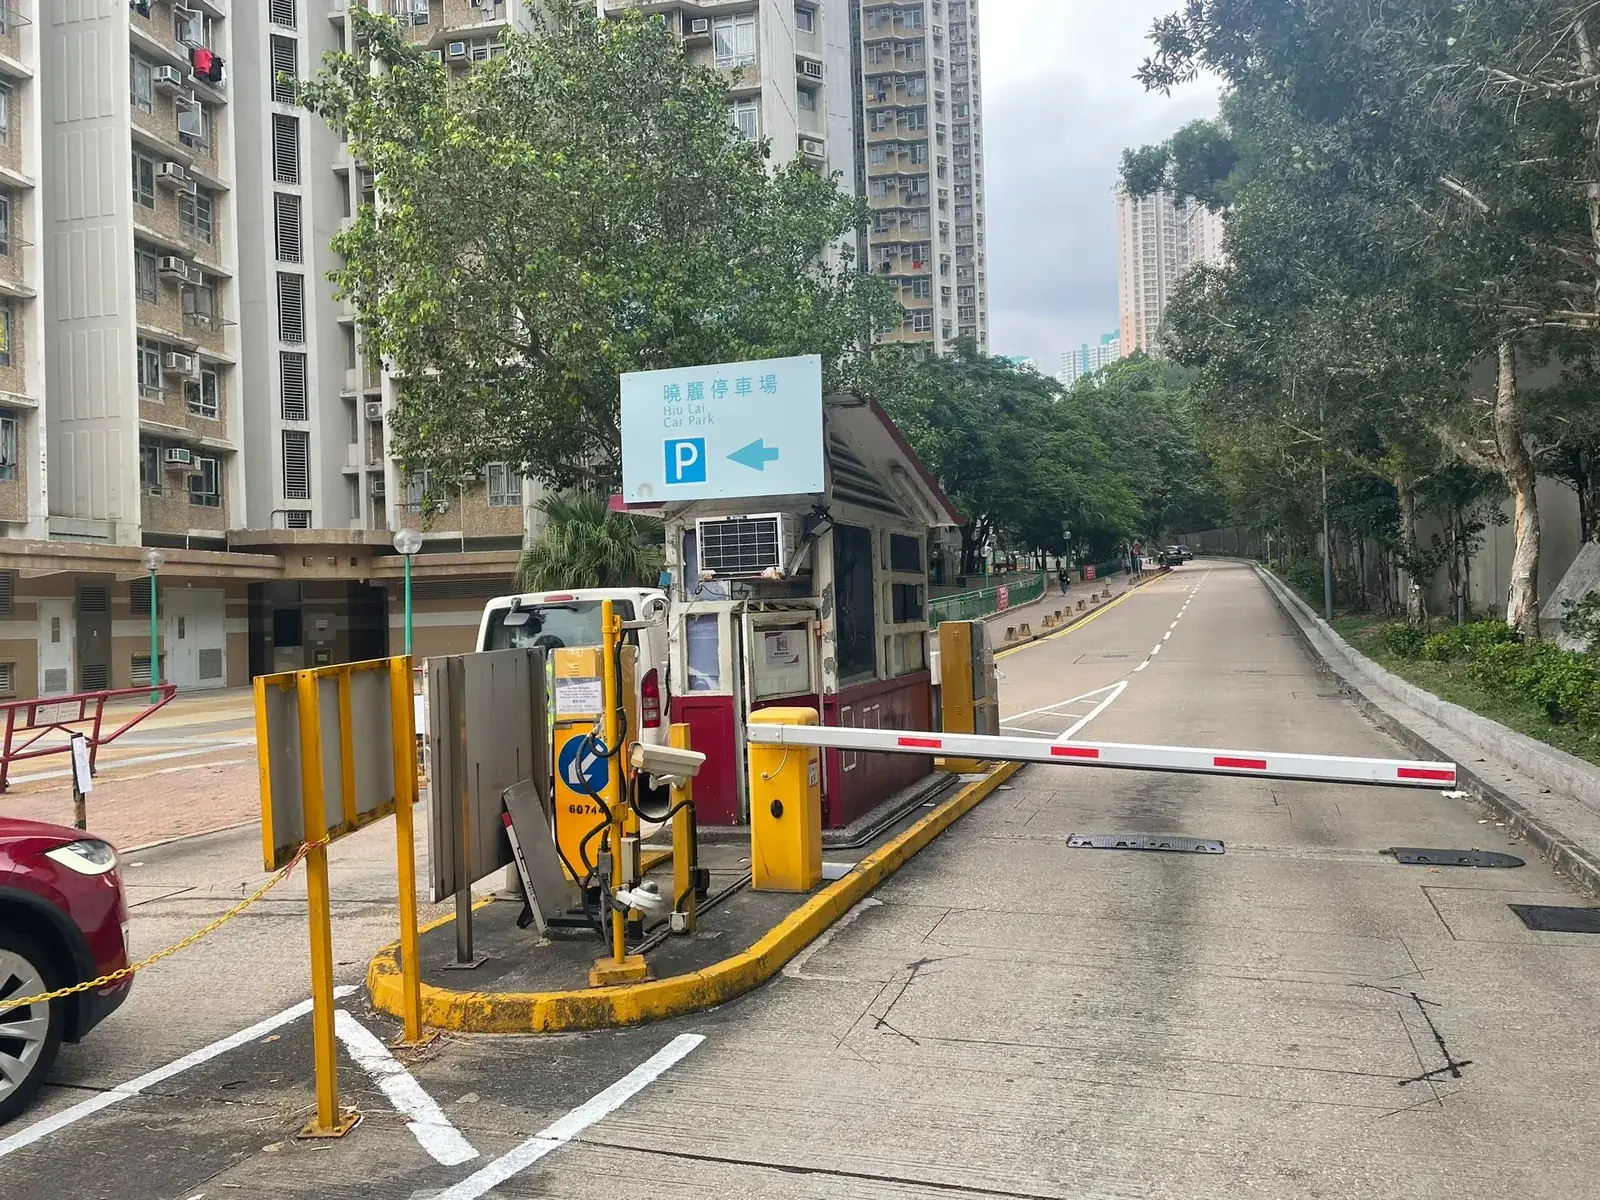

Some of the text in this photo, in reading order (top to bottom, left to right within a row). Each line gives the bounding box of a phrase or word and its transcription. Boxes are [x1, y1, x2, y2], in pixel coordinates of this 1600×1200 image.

[663, 374, 778, 403] 曉麗停車場
[663, 403, 705, 416] Hiu Lai
[663, 412, 715, 427] Car Park
[675, 442, 698, 480] P
